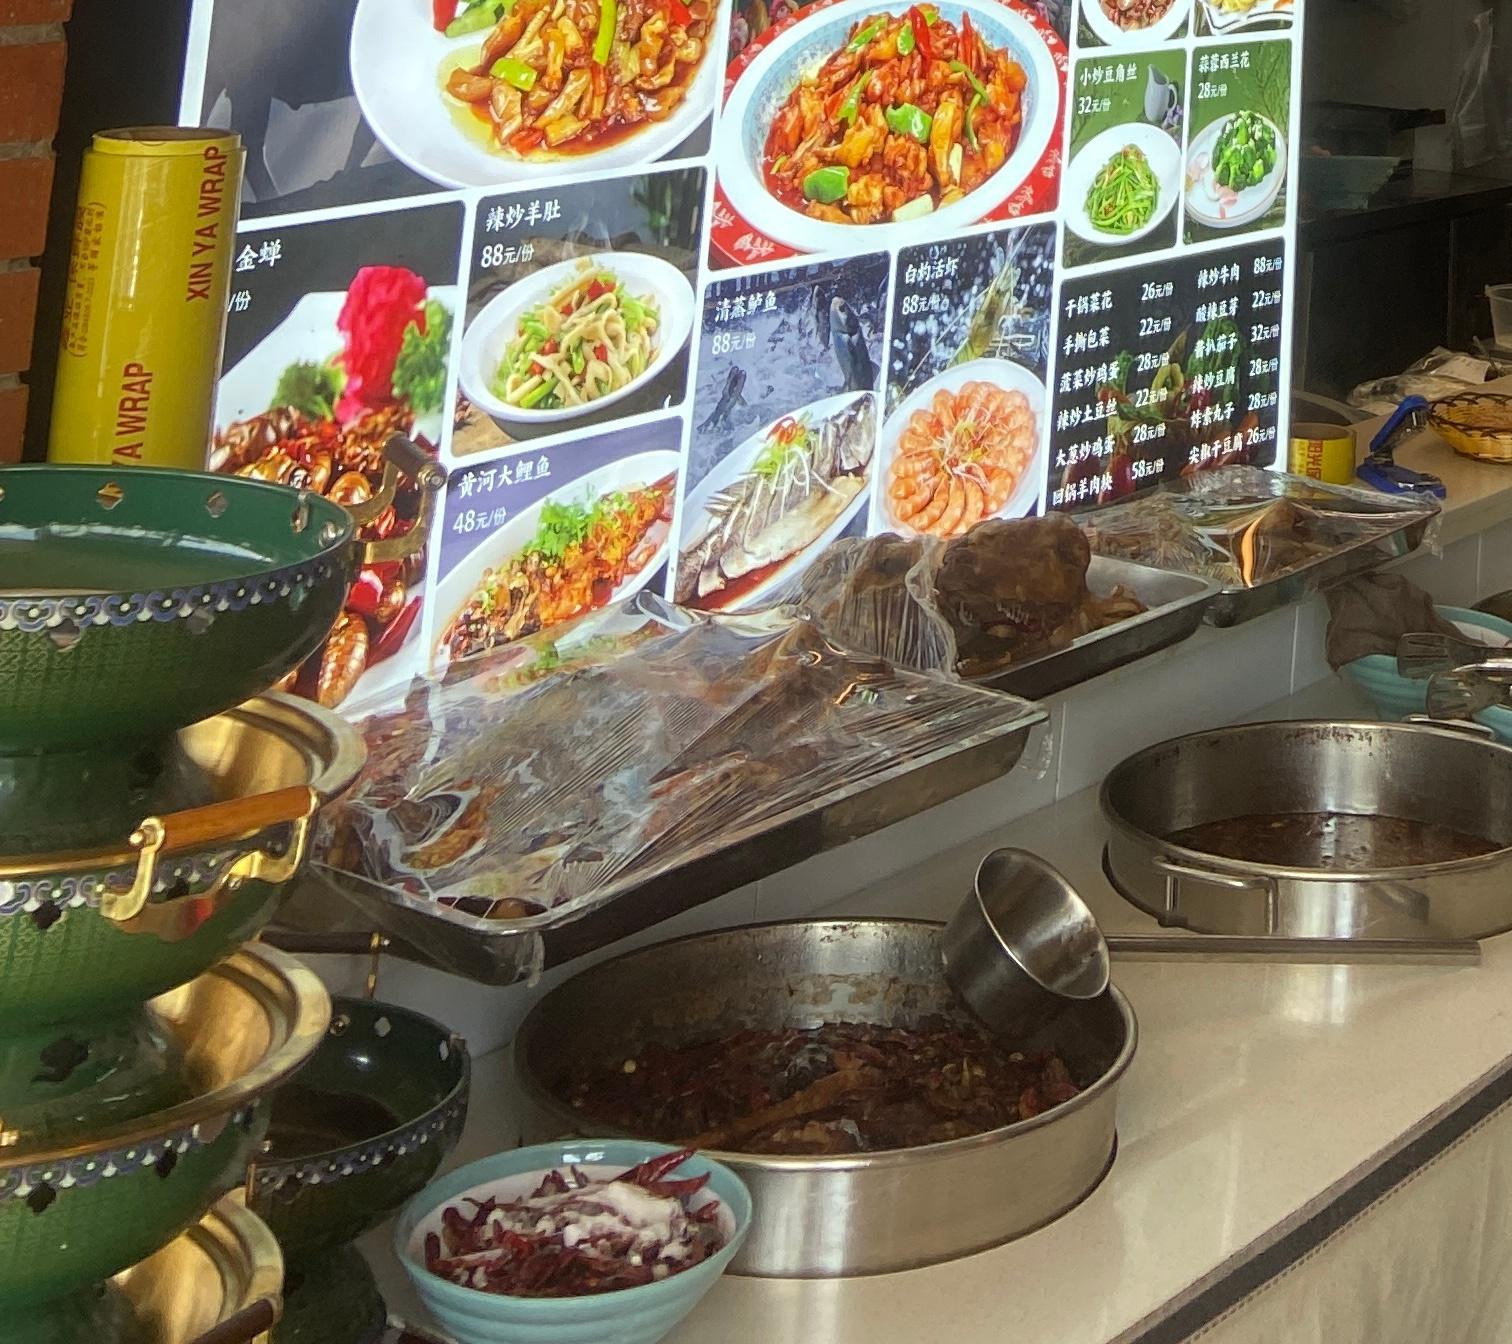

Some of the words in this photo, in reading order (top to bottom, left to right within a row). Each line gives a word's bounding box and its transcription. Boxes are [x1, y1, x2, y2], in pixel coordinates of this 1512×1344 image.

[1080, 63, 1137, 86] 小炒豆角丝
[1198, 82, 1228, 98] 28元/份
[1078, 97, 1111, 114] 32元/份
[199, 145, 229, 220] WRAP
[486, 199, 561, 232] 辣炒羊肚
[192, 221, 217, 257] YA
[236, 239, 281, 271] 金蝉
[481, 243, 534, 268] 88元/份
[1254, 257, 1282, 274] 88元/份
[186, 259, 214, 302] XIN
[906, 257, 959, 284] 白灼活虾
[715, 290, 777, 322] 清蒸鲈鱼
[1065, 290, 1113, 318] 干锅菜花
[1142, 282, 1174, 300] 26元/份
[1252, 290, 1281, 308] 22元/份
[1139, 317, 1172, 336] 22元/份
[1251, 323, 1280, 342] 32元/份
[712, 332, 756, 355] 88元/份
[1137, 352, 1170, 372] 28元/份
[1249, 357, 1278, 376] 28元/份
[121, 362, 154, 439] WRAP
[1135, 387, 1168, 407] 22元/份
[1248, 391, 1277, 411] 28元/份
[1133, 422, 1166, 444] 28元/份
[1247, 427, 1275, 445] 26元/份
[458, 455, 552, 497] 黄河大鲤鱼
[1132, 458, 1164, 479] 58元/份
[453, 507, 506, 533] 48元/份
